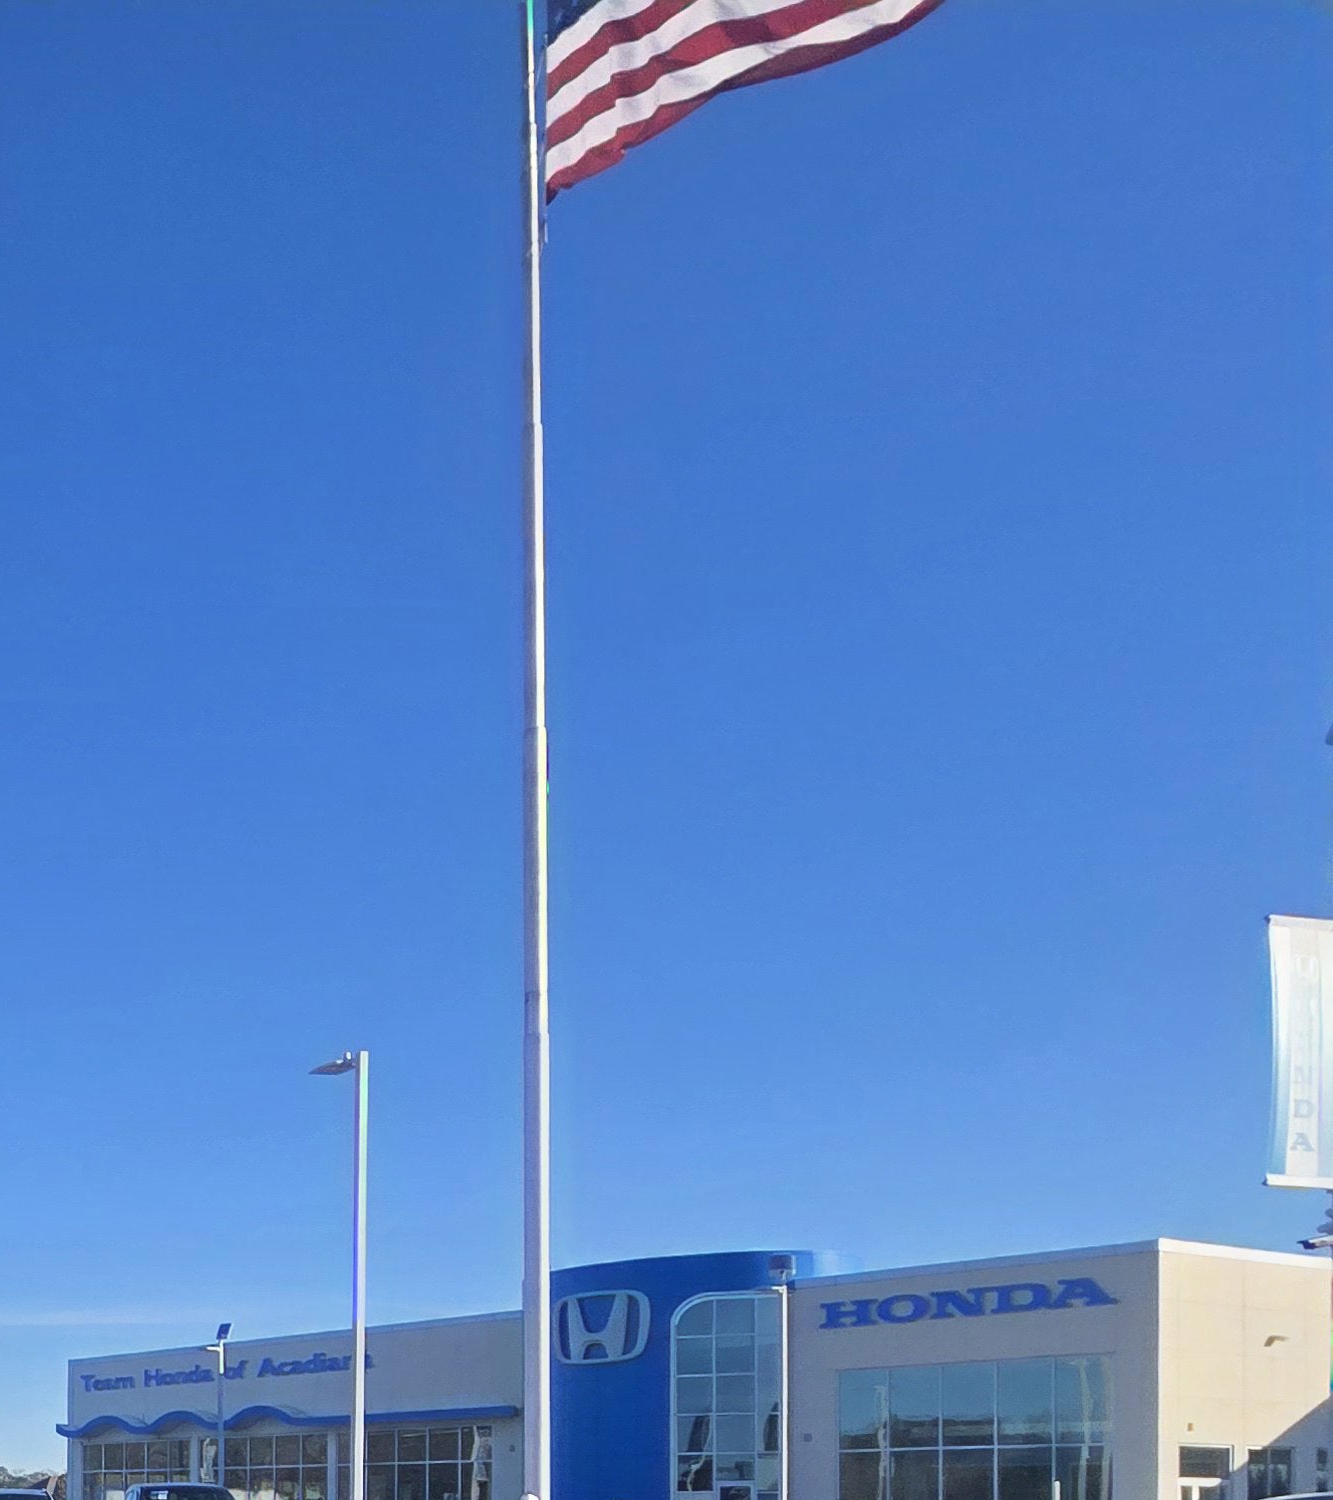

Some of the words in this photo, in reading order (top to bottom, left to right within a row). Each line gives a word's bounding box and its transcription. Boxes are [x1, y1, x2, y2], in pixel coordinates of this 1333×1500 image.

[819, 1277, 1118, 1329] HONDA
[80, 1374, 135, 1392] Team
[144, 1365, 215, 1388] Honda
[224, 1359, 249, 1380] of
